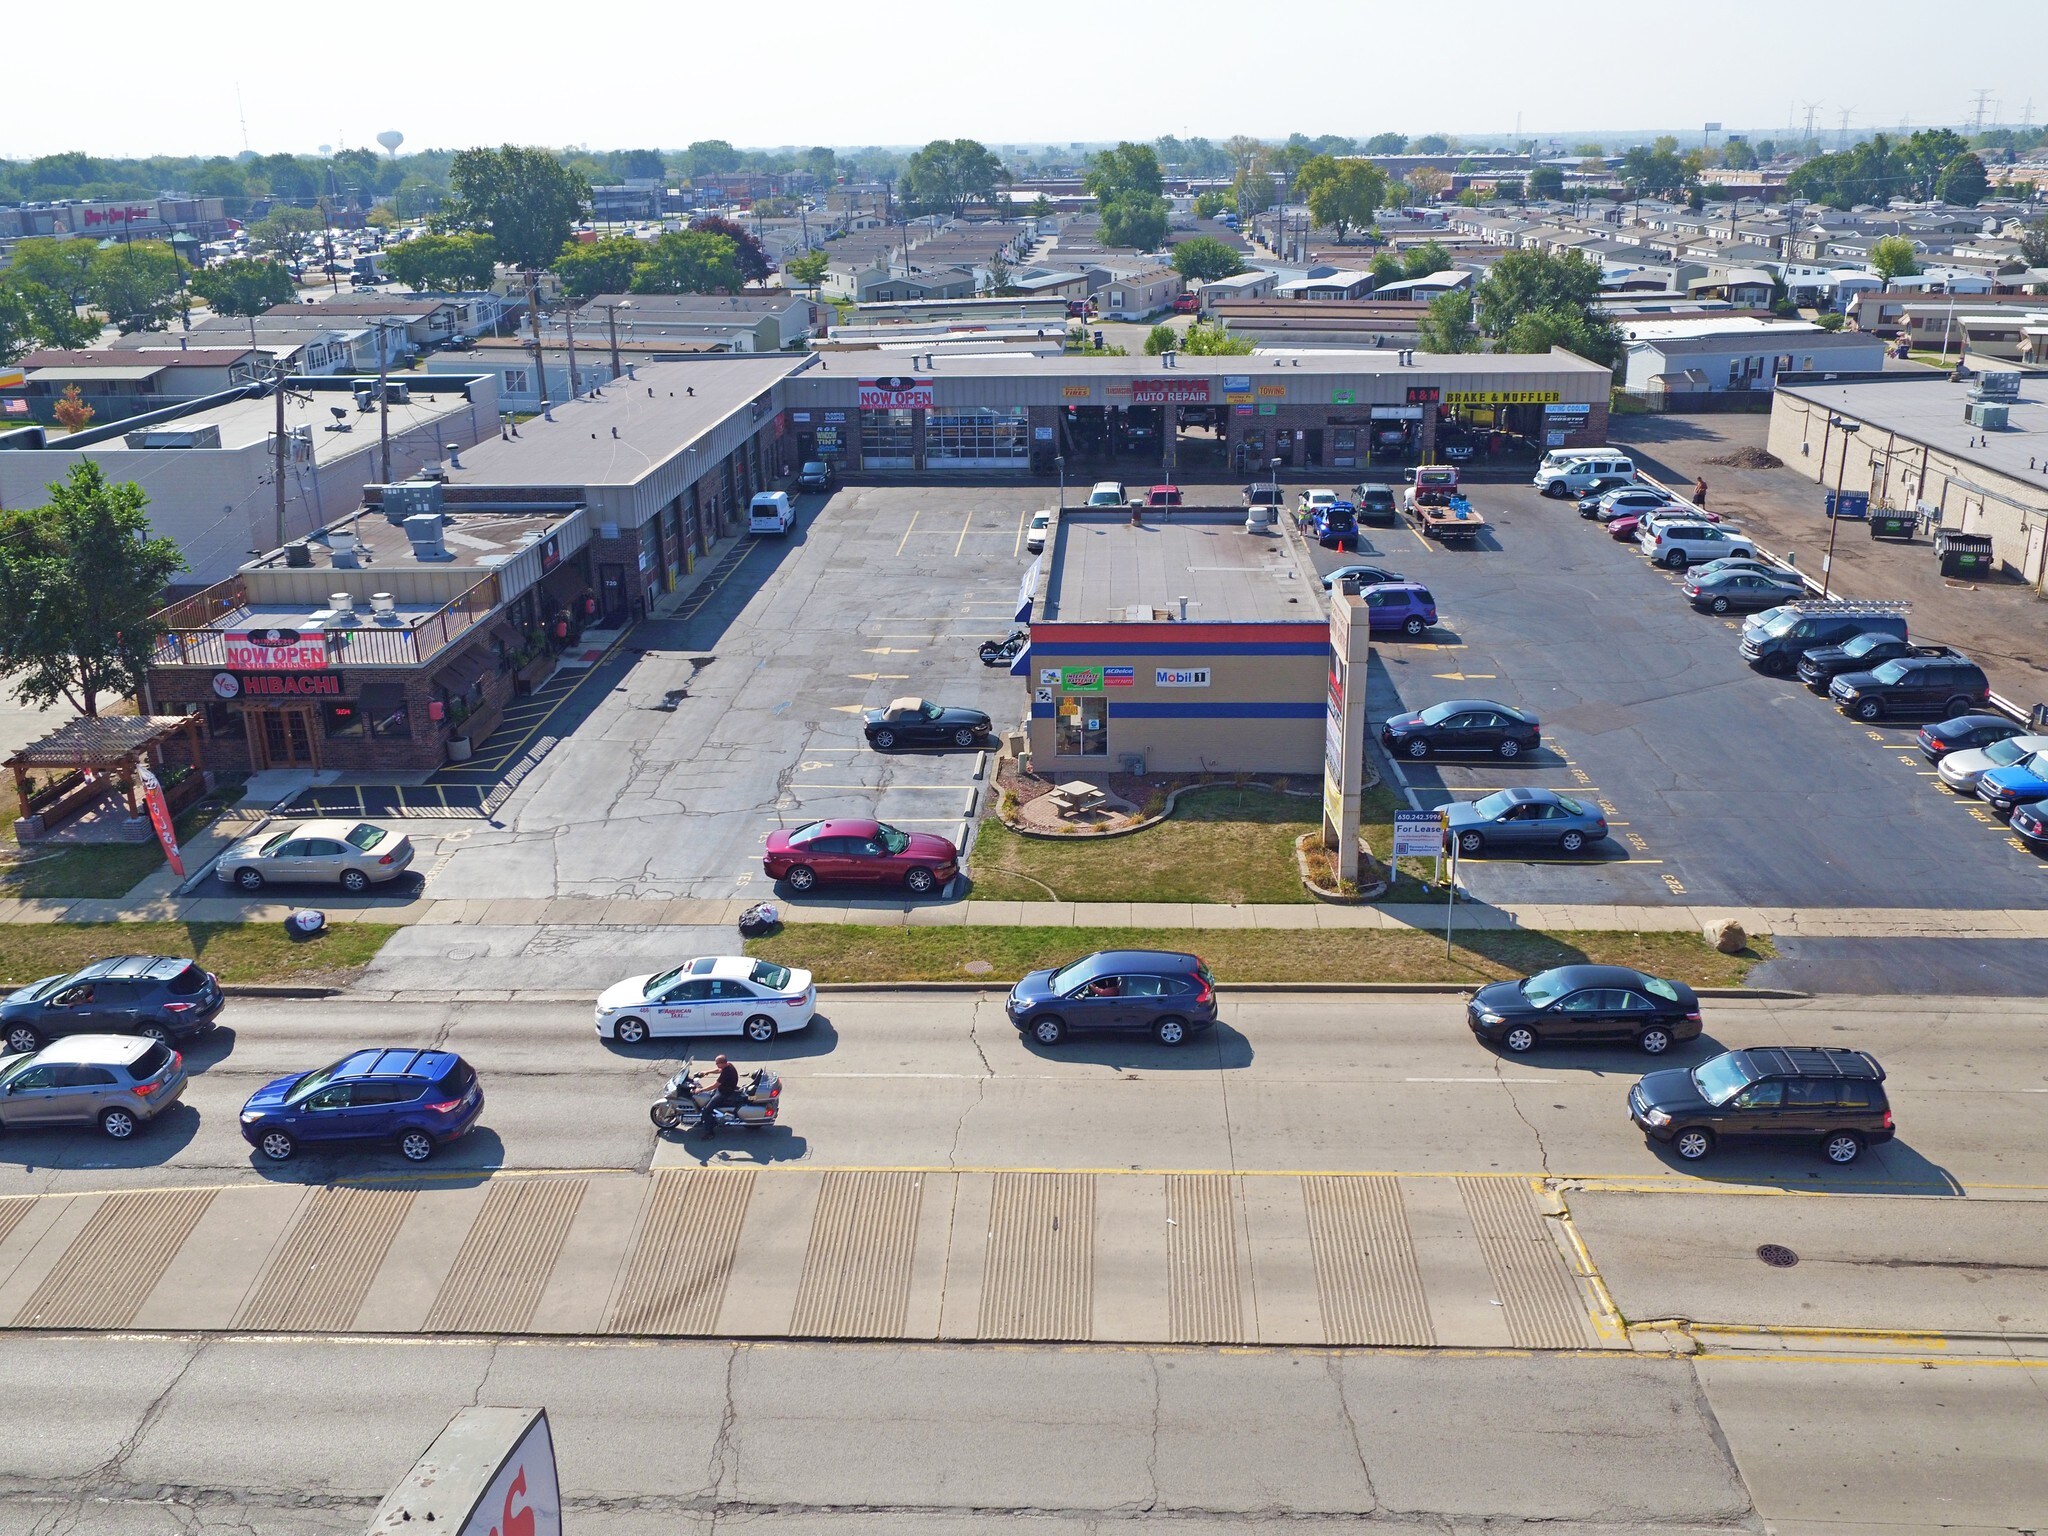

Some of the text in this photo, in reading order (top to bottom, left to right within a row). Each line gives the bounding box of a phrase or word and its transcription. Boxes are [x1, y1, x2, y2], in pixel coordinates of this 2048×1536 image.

[861, 391, 932, 405] NOW OPEN
[1135, 392, 1207, 401] AUTO REPAIR
[1259, 386, 1285, 396] TOWING
[1408, 389, 1439, 400] A & M
[1446, 392, 1560, 403] BRAKE & MUFFLER
[227, 647, 324, 663] NOW OPEN
[1157, 671, 1192, 683] Mobil
[214, 676, 339, 694] Yes HIBACHI
[1898, 755, 1918, 767] YES
[1571, 768, 1592, 784] 7223
[1597, 798, 1620, 816] 7223
[1396, 824, 1441, 833] For Lease
[1625, 832, 1650, 851] 7223
[736, 871, 754, 887] YES
[1661, 874, 1688, 895] 7223
